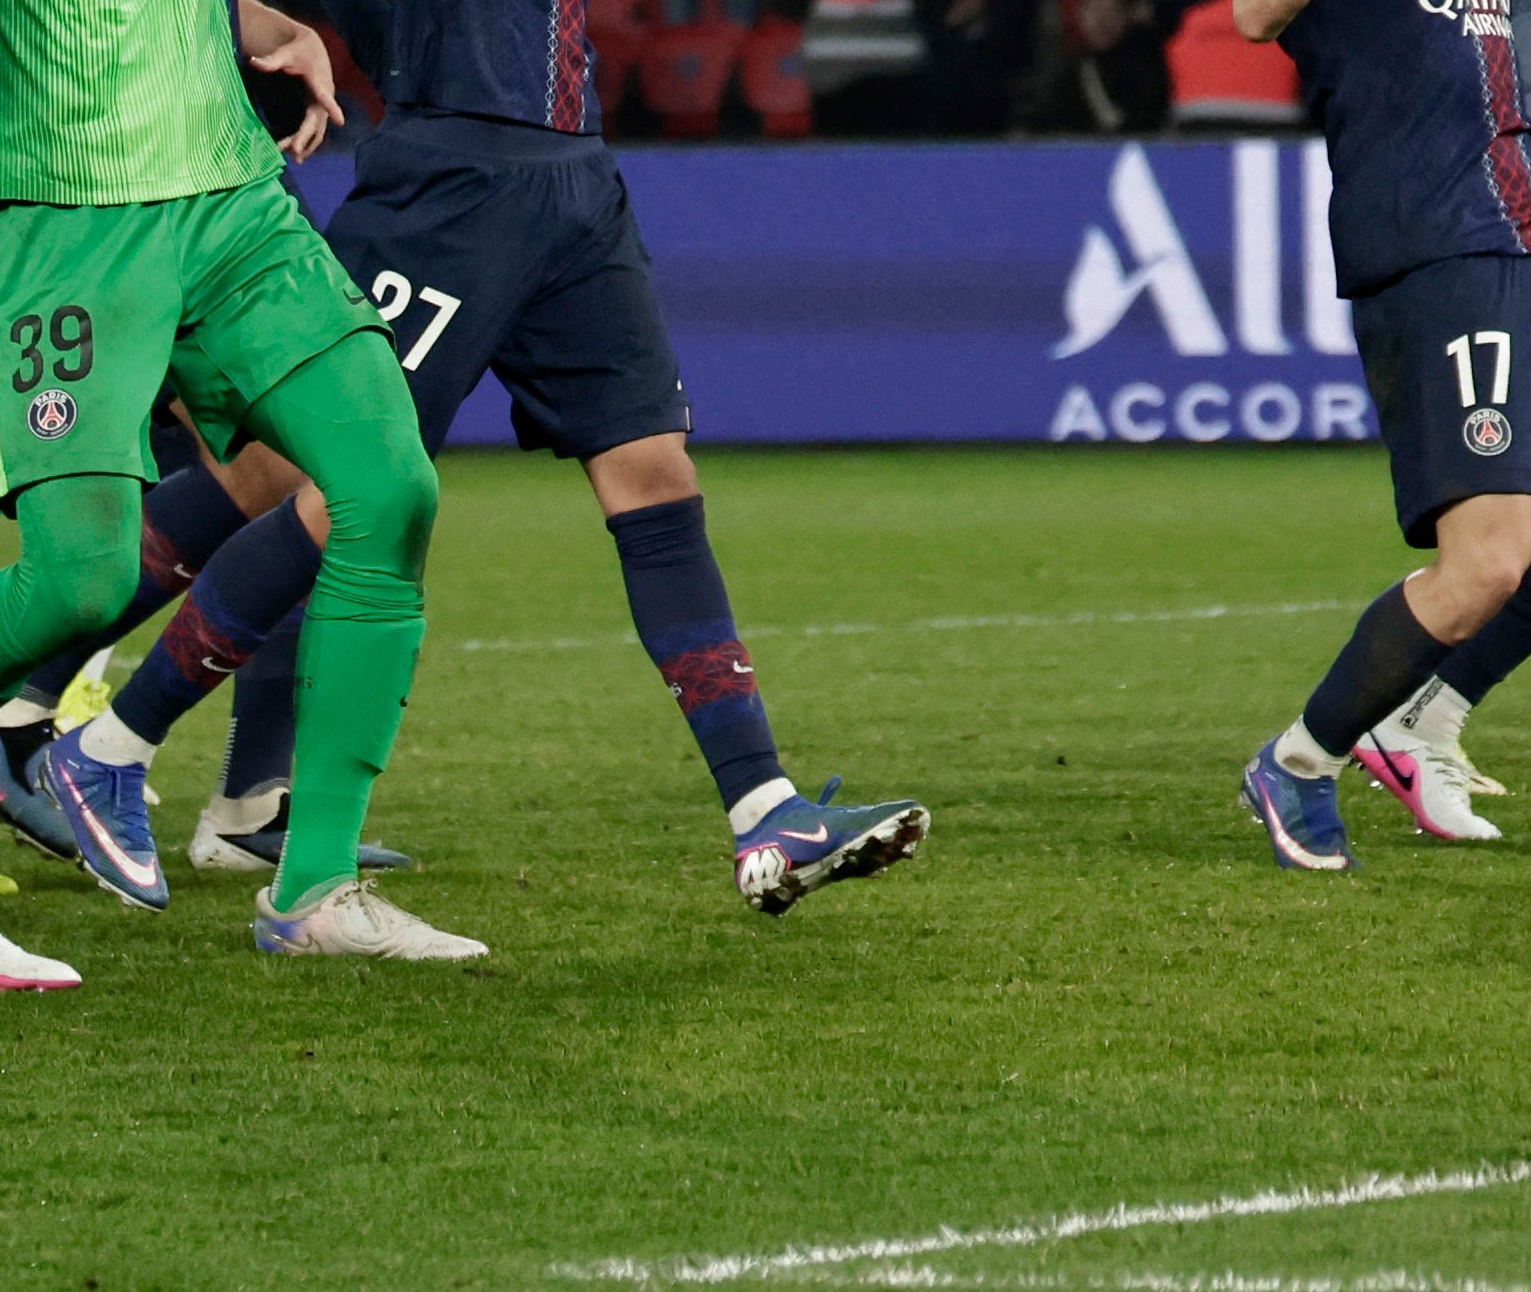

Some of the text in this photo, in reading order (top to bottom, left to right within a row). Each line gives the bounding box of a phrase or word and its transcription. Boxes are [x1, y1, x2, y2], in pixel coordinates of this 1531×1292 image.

[11, 304, 94, 394] 39
[371, 269, 463, 372] 27
[35, 391, 68, 407] PARIS
[1446, 331, 1511, 408] 17
[1048, 380, 1370, 443] ACCOR
